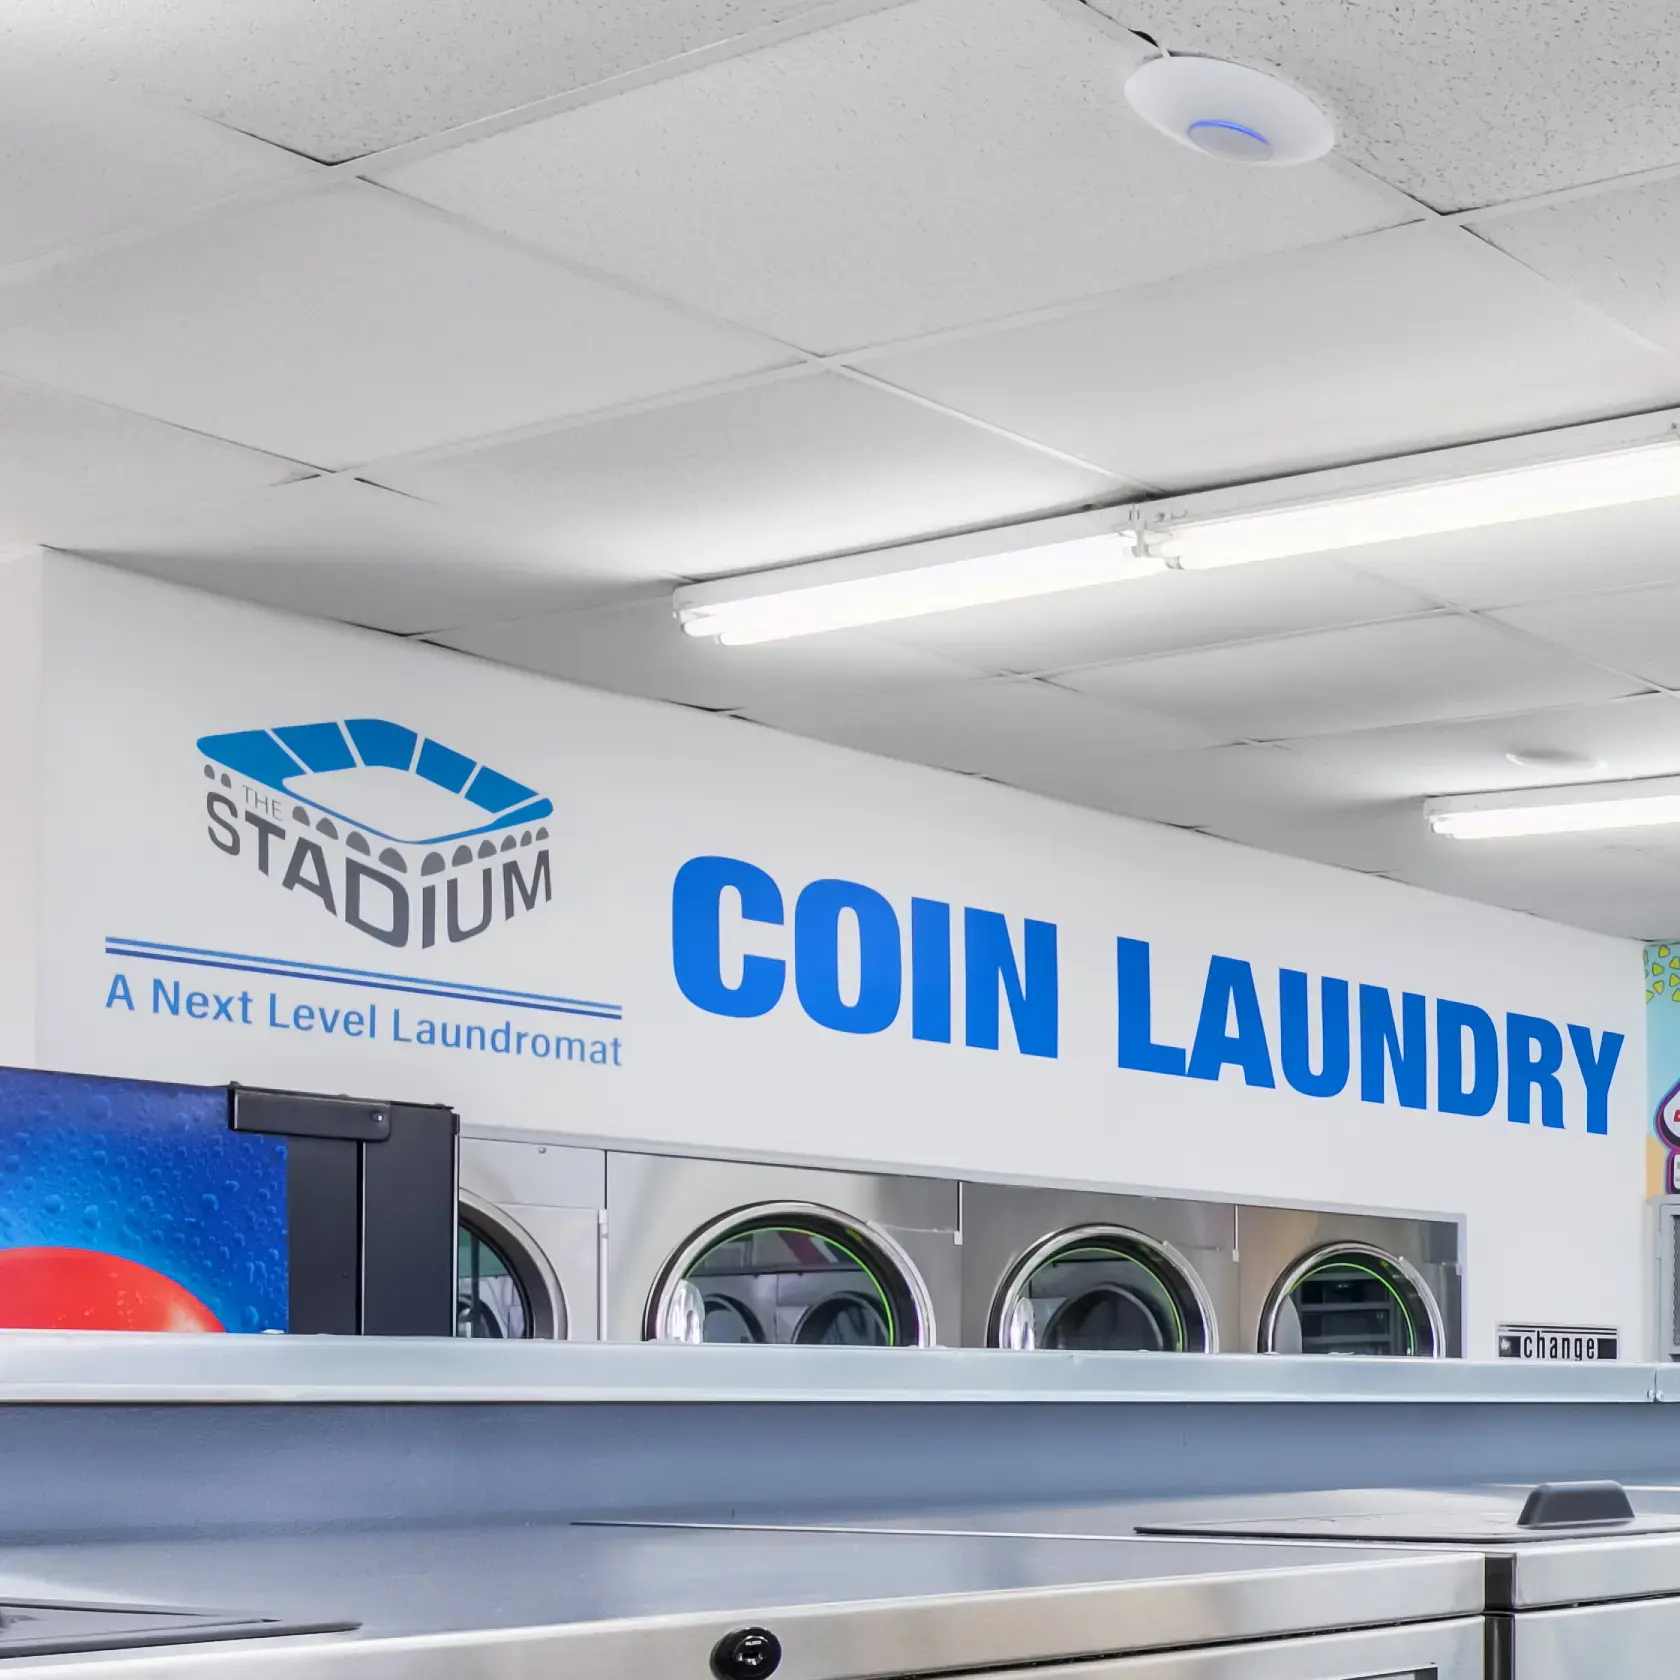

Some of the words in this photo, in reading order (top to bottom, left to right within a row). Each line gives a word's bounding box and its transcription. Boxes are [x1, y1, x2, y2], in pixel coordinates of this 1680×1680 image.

[242, 785, 284, 821] THE
[204, 791, 553, 950] STADIUM
[105, 974, 135, 1012] A
[151, 978, 254, 1026] Next
[269, 994, 379, 1041] Level
[393, 1008, 623, 1067] Laundromat
[672, 855, 1058, 1059] COIN
[1116, 936, 1625, 1135] LAUNDRY
[1523, 1330, 1595, 1361] change
